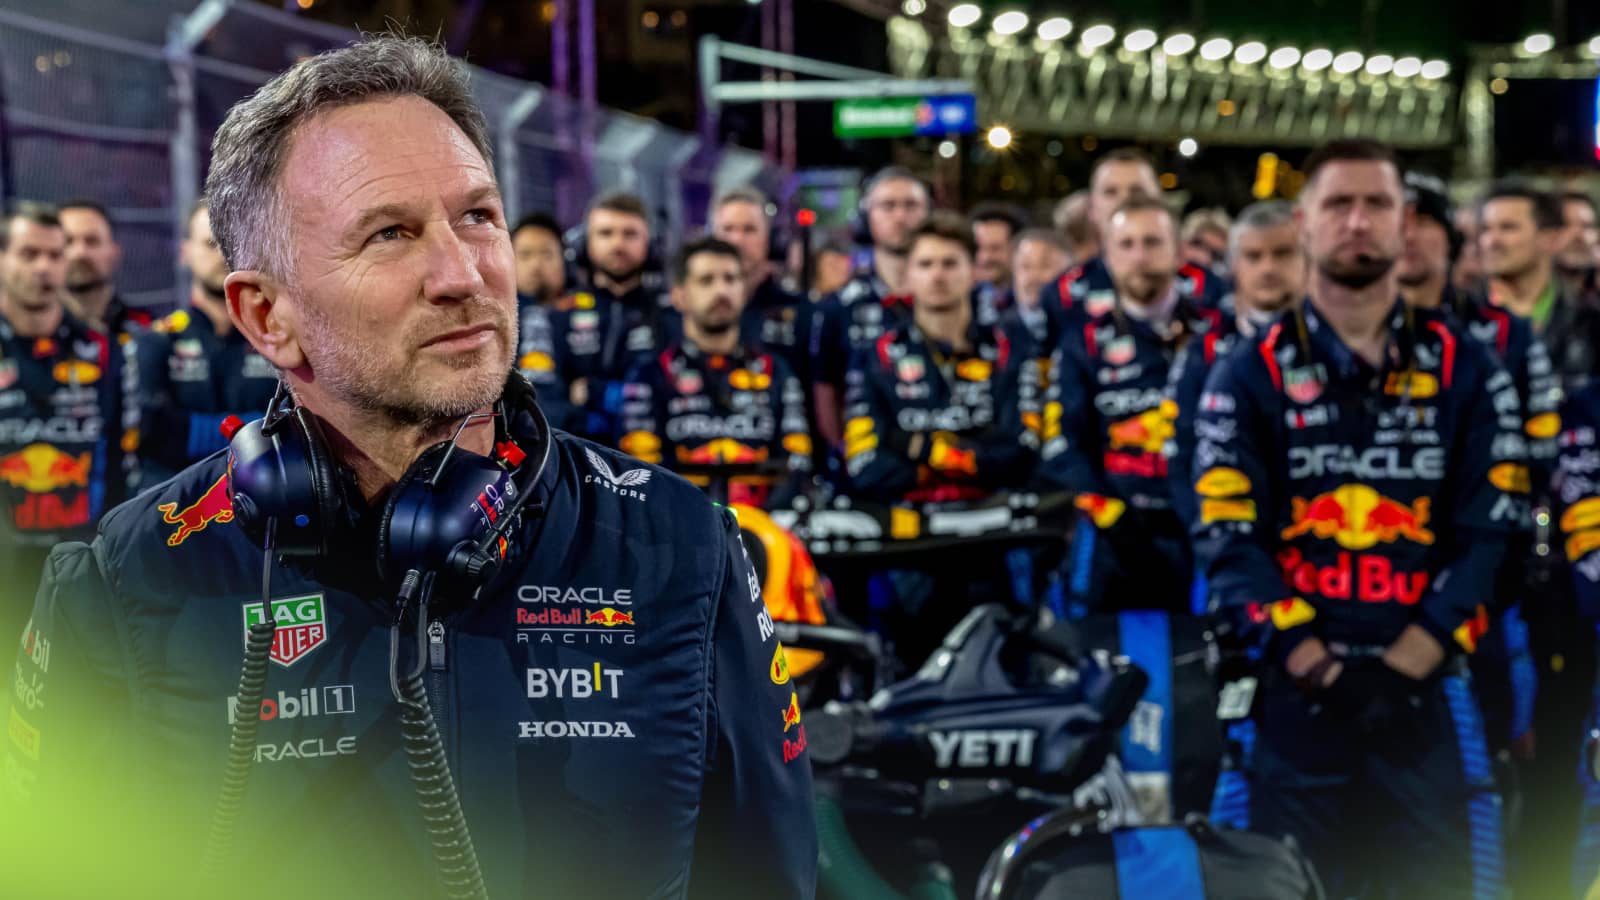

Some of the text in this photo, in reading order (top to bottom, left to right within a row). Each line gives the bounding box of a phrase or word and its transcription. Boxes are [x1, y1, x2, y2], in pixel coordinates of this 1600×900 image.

[585, 475, 647, 501] CASTORE
[1358, 554, 1428, 605] Bu
[517, 586, 633, 605] ORACLE
[250, 601, 318, 624] TAG
[517, 609, 582, 625] Red Bull
[269, 626, 320, 660] UER
[517, 633, 636, 645] RACING
[527, 662, 624, 698] BYBIT
[518, 721, 636, 738] HONDA
[253, 736, 358, 763] RACLE
[928, 730, 1038, 769] YETI
